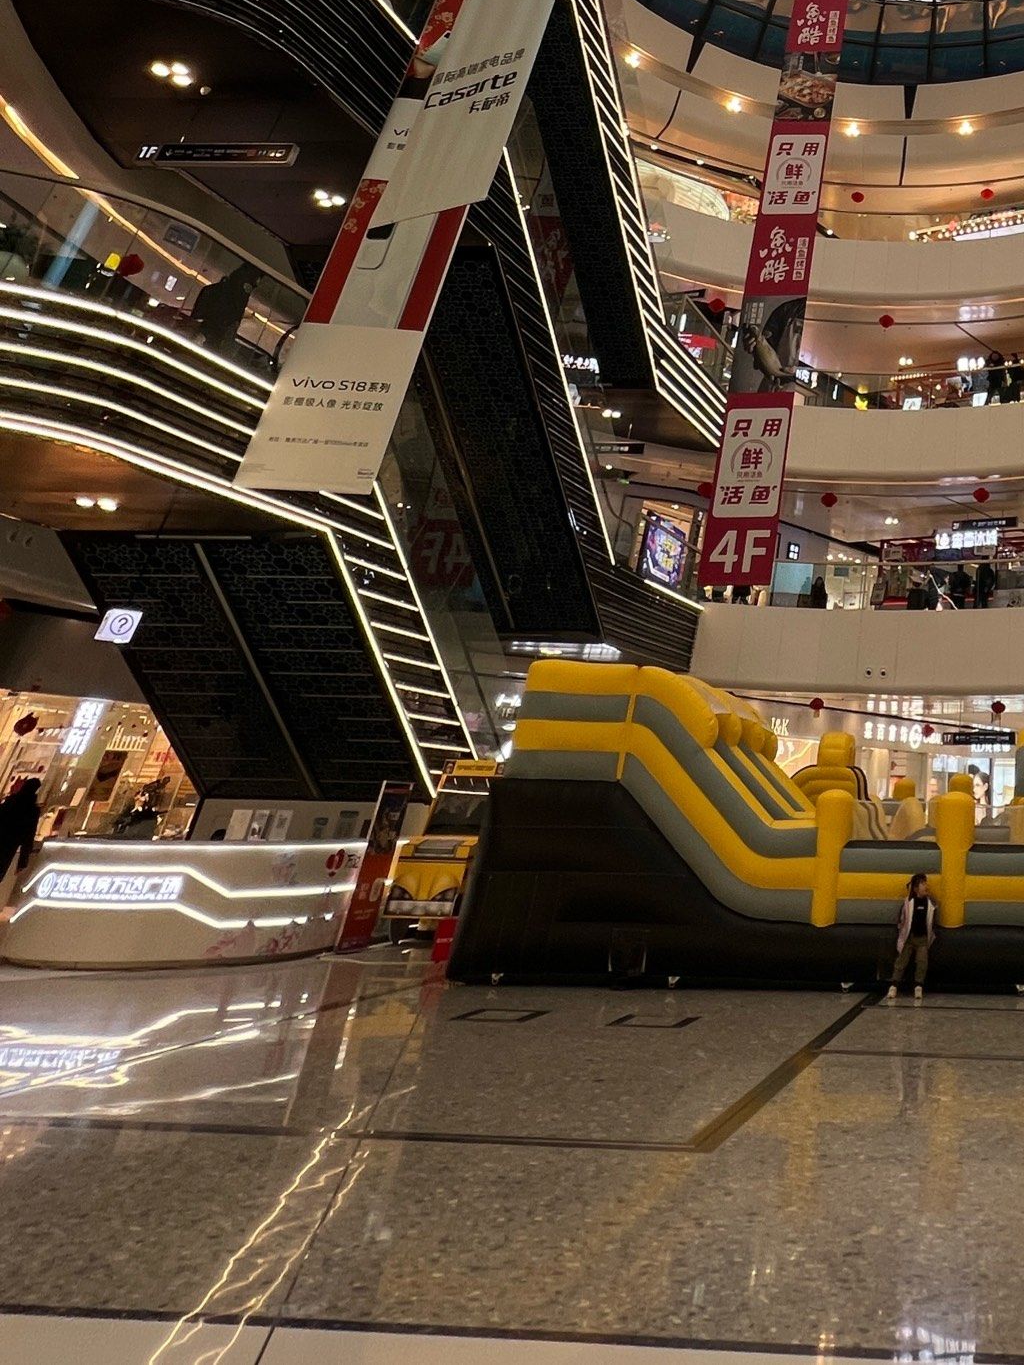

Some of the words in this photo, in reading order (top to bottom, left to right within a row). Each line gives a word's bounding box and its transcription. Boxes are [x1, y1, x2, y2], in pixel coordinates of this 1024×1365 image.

[432, 48, 526, 86] 国际高端家电品牌
[424, 70, 519, 111] Casarte
[468, 91, 512, 115] 卡萨帝
[138, 146, 159, 159] 1F
[775, 142, 820, 156] 只用
[784, 163, 803, 180] 鲜
[292, 376, 335, 389] vivo
[338, 380, 392, 395] S18系列
[340, 400, 385, 412] 光彩绽放
[730, 418, 783, 438] 只用
[740, 447, 764, 470] 鲜
[709, 529, 772, 575] 4F
